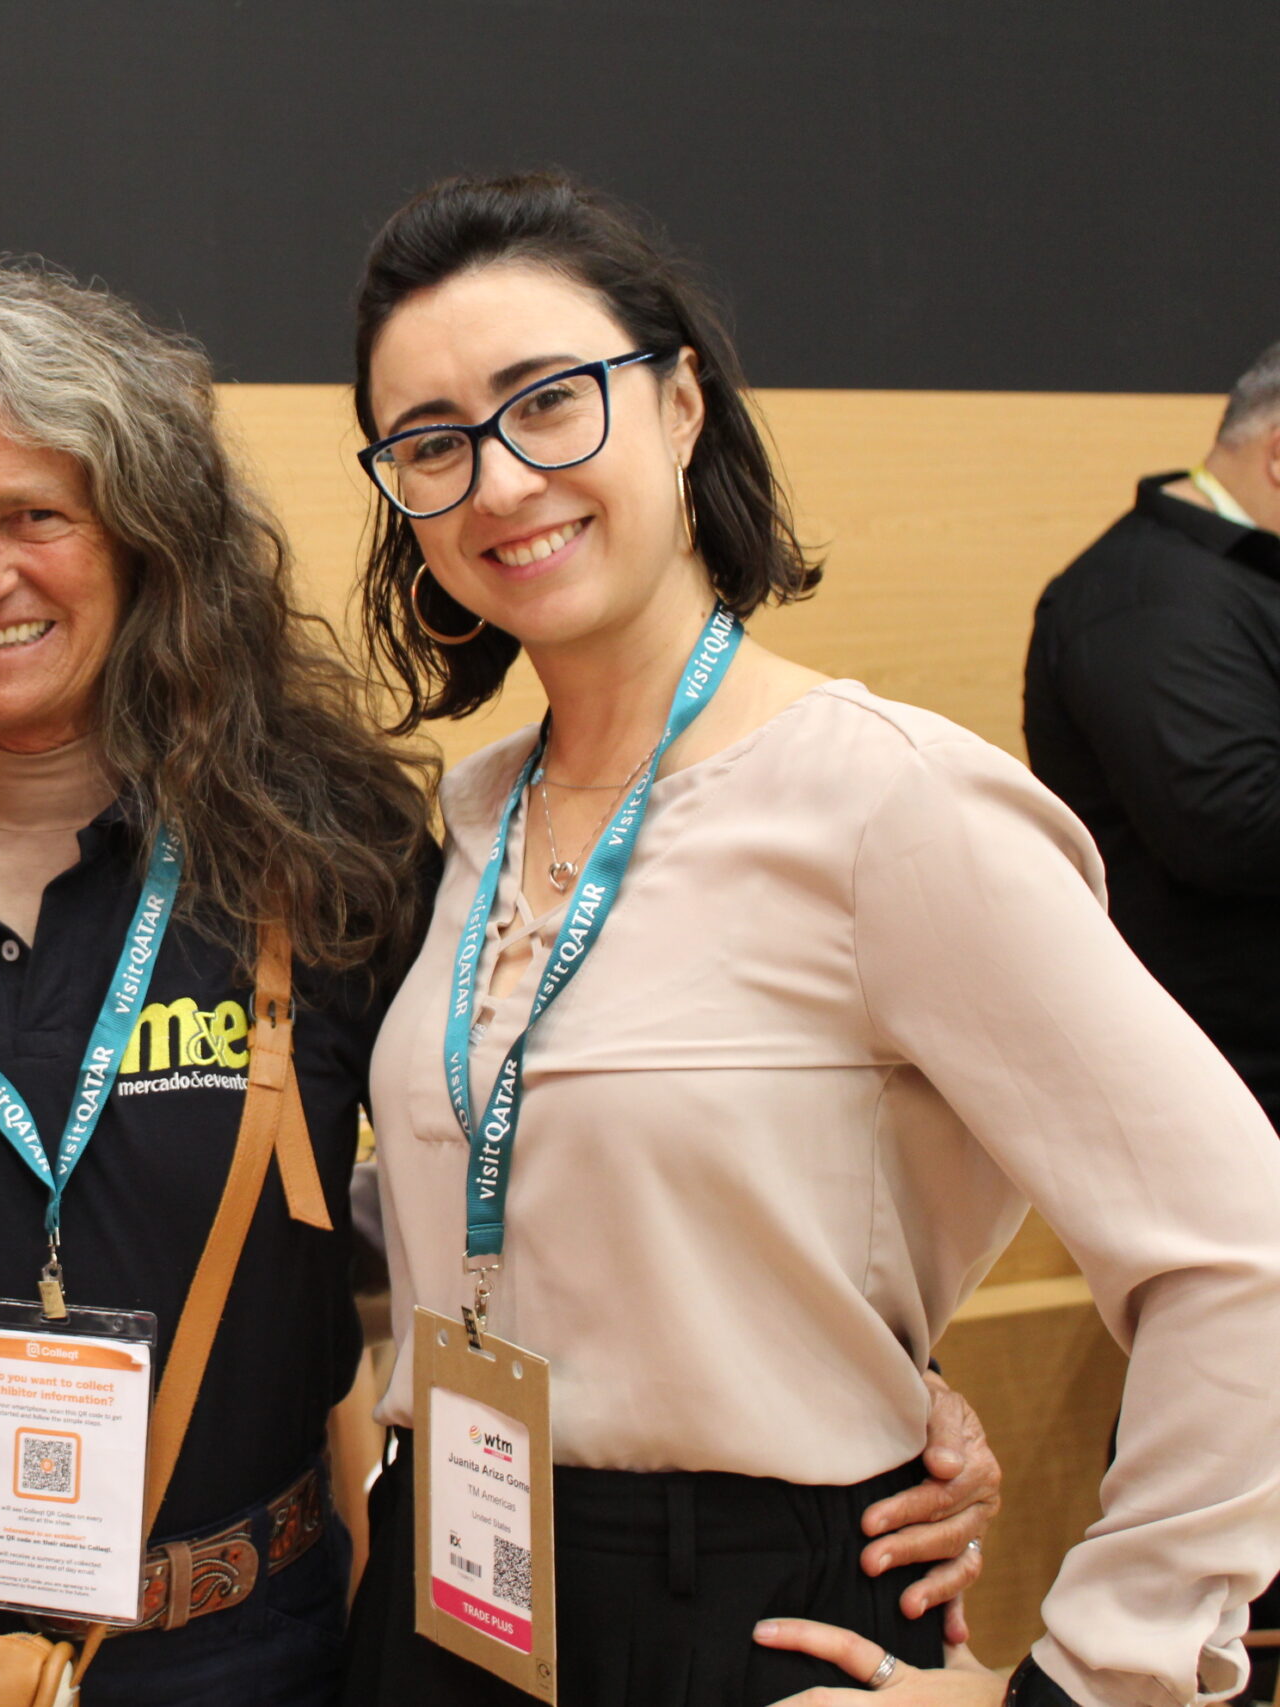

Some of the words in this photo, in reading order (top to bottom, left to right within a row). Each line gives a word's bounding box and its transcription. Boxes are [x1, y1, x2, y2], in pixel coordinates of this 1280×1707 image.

[115, 894, 165, 1014] visitQATAR
[455, 893, 486, 1018] visitQATAR
[535, 883, 608, 1014] visitQATAR
[119, 997, 250, 1074] m&e
[56, 1045, 116, 1175] visitQATAR
[478, 1059, 518, 1199] visitQATAR
[41, 1346, 79, 1360] Colleqt
[8, 1371, 26, 1383] you
[30, 1374, 56, 1386] want
[60, 1377, 72, 1388] to
[75, 1379, 114, 1392] collect
[40, 1389, 114, 1407] information?
[484, 1433, 513, 1455] wtm
[448, 1452, 480, 1473] Juanita
[482, 1465, 505, 1482] Ariza
[467, 1483, 480, 1497] TM
[481, 1490, 516, 1512] Americas
[471, 1510, 492, 1525] United
[493, 1518, 512, 1534] States
[461, 1601, 490, 1624] TRADE
[491, 1615, 515, 1635] PLUS
